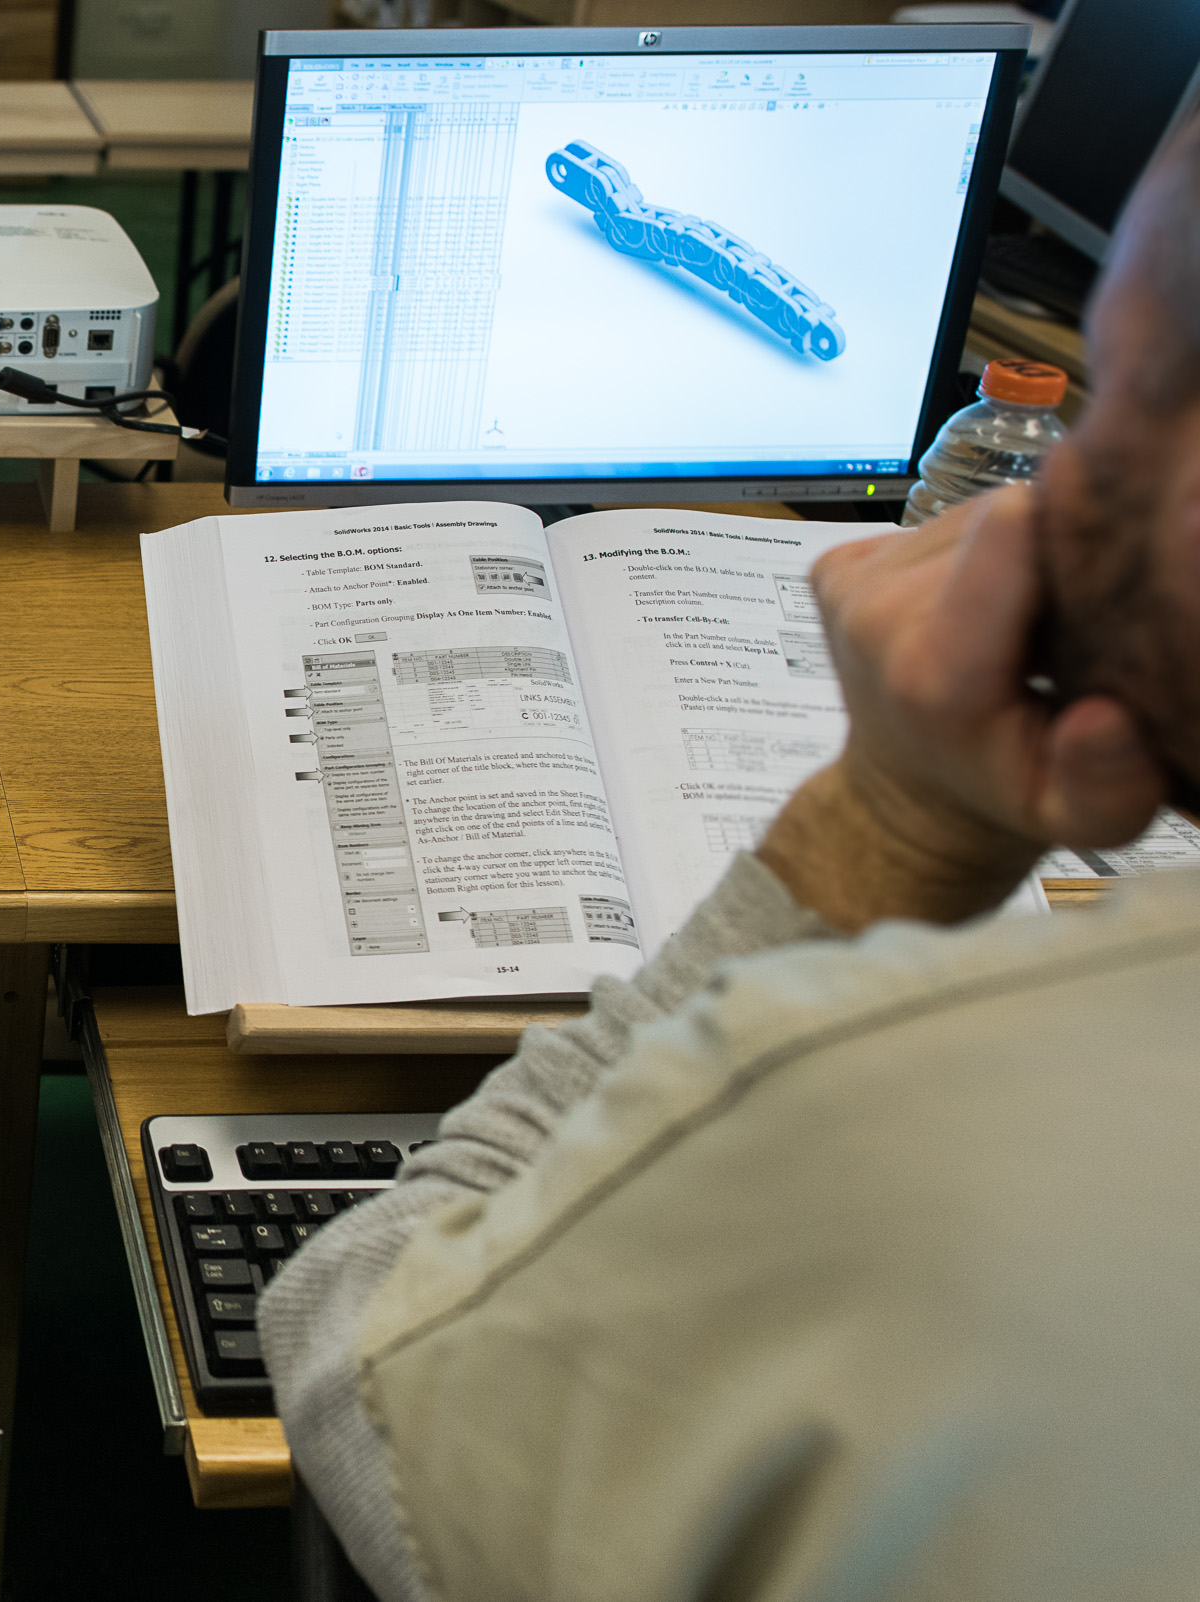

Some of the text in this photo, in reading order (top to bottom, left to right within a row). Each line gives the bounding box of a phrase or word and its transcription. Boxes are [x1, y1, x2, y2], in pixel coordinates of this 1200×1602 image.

[333, 527, 372, 535] SolidWorks
[744, 535, 773, 544] Assembly
[772, 538, 802, 546] Drawings
[279, 553, 319, 561] Selecting
[336, 548, 365, 557] B.O.M.
[366, 546, 402, 555] options:
[582, 553, 597, 562] 13.
[598, 548, 643, 558] Modifying
[326, 566, 362, 574] Template:
[363, 563, 385, 571] BOM
[385, 560, 423, 569] Standard.
[311, 602, 332, 610] BOM
[332, 602, 354, 610] Type:
[376, 597, 396, 605] only.
[685, 615, 730, 625] Cell-By-Cell:
[529, 678, 564, 688] SolidWorks
[519, 694, 542, 702] LINKS
[532, 711, 571, 722] 001-12345
[425, 878, 565, 894] Bottom Right option for this lesson).
[496, 965, 520, 973] 15-14
[254, 1147, 266, 1155] F1
[332, 1147, 343, 1155] F3
